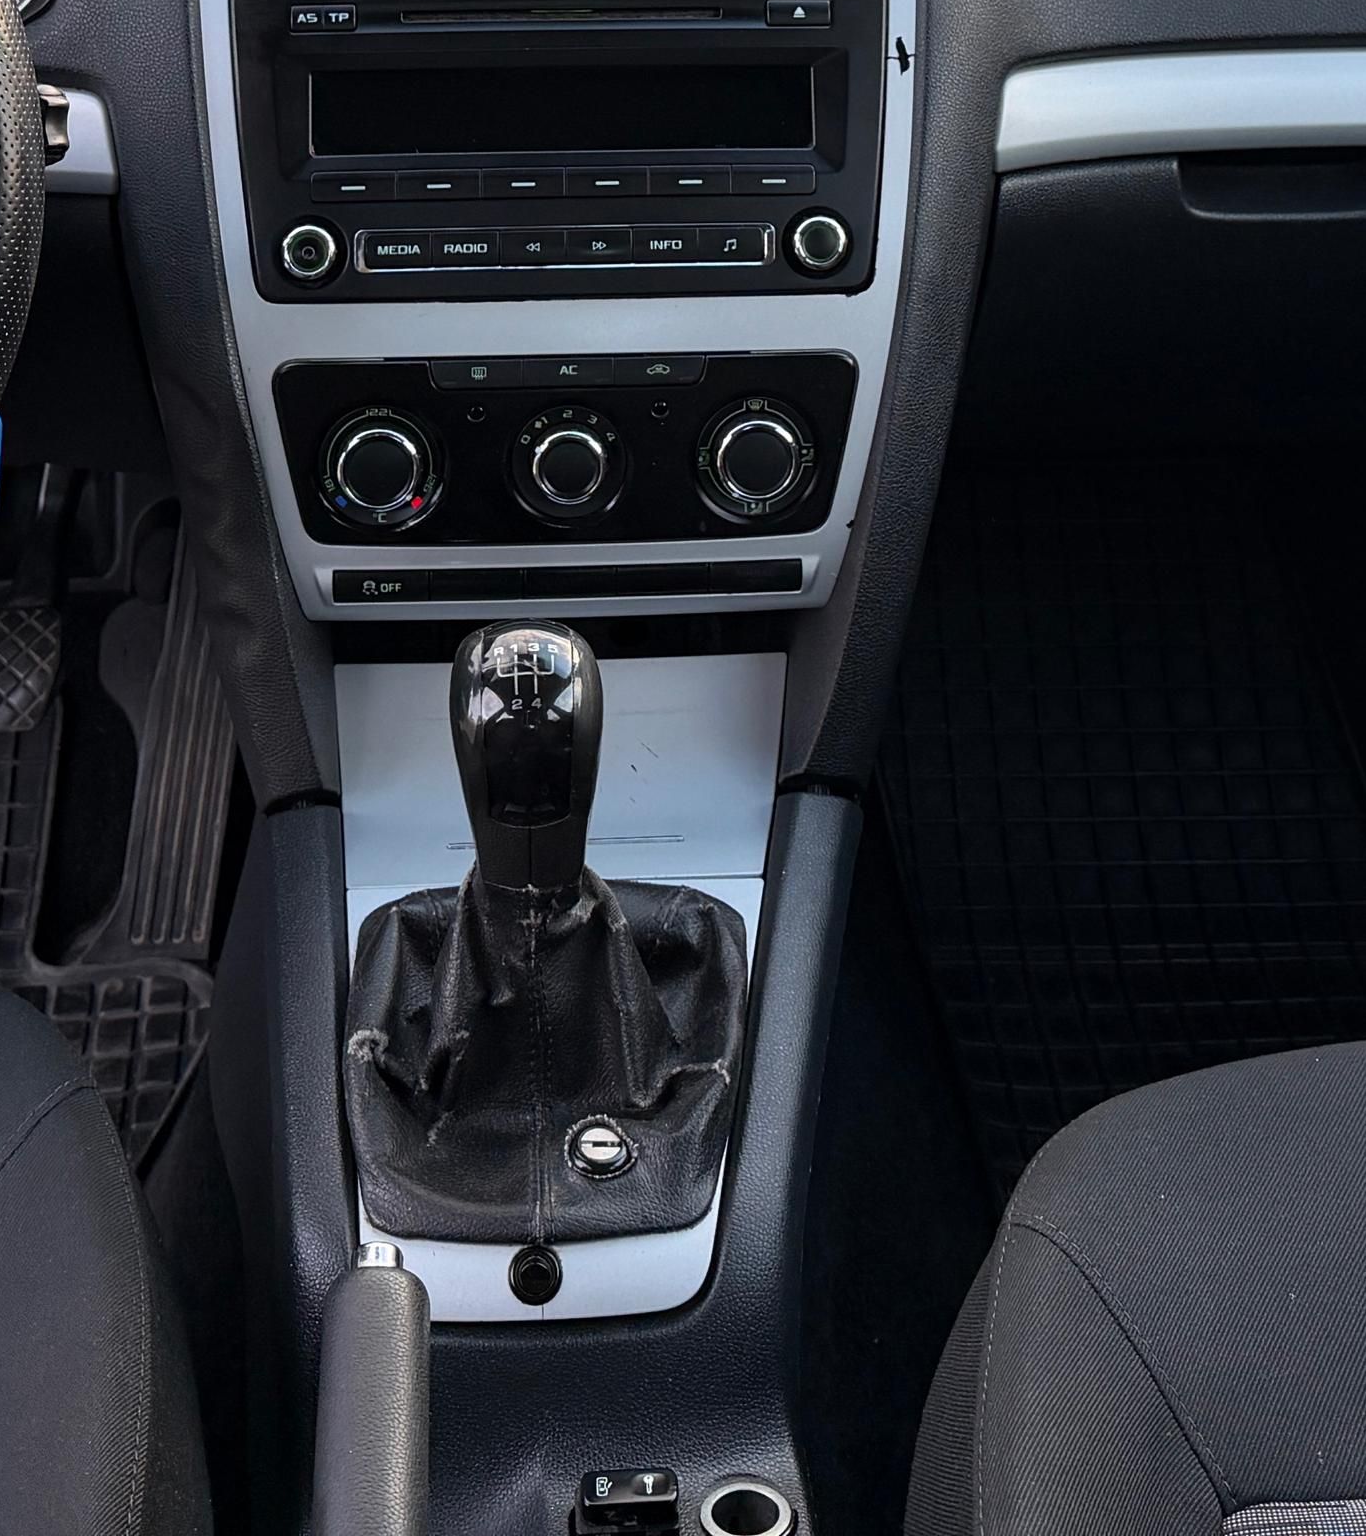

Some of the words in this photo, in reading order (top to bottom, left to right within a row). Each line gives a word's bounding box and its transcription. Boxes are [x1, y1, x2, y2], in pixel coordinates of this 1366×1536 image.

[297, 13, 318, 24] AS
[328, 12, 350, 23] TP
[377, 245, 421, 256] MEDIA
[443, 243, 488, 254] RADIO
[650, 240, 682, 250] INFO
[559, 365, 578, 375] AC
[587, 414, 598, 425] 3
[606, 432, 616, 442] 4
[380, 583, 402, 593] OFF
[494, 647, 504, 656] R
[528, 642, 540, 652] 3
[547, 643, 558, 653] 5
[511, 698, 523, 710] 2
[531, 697, 542, 709] 4
